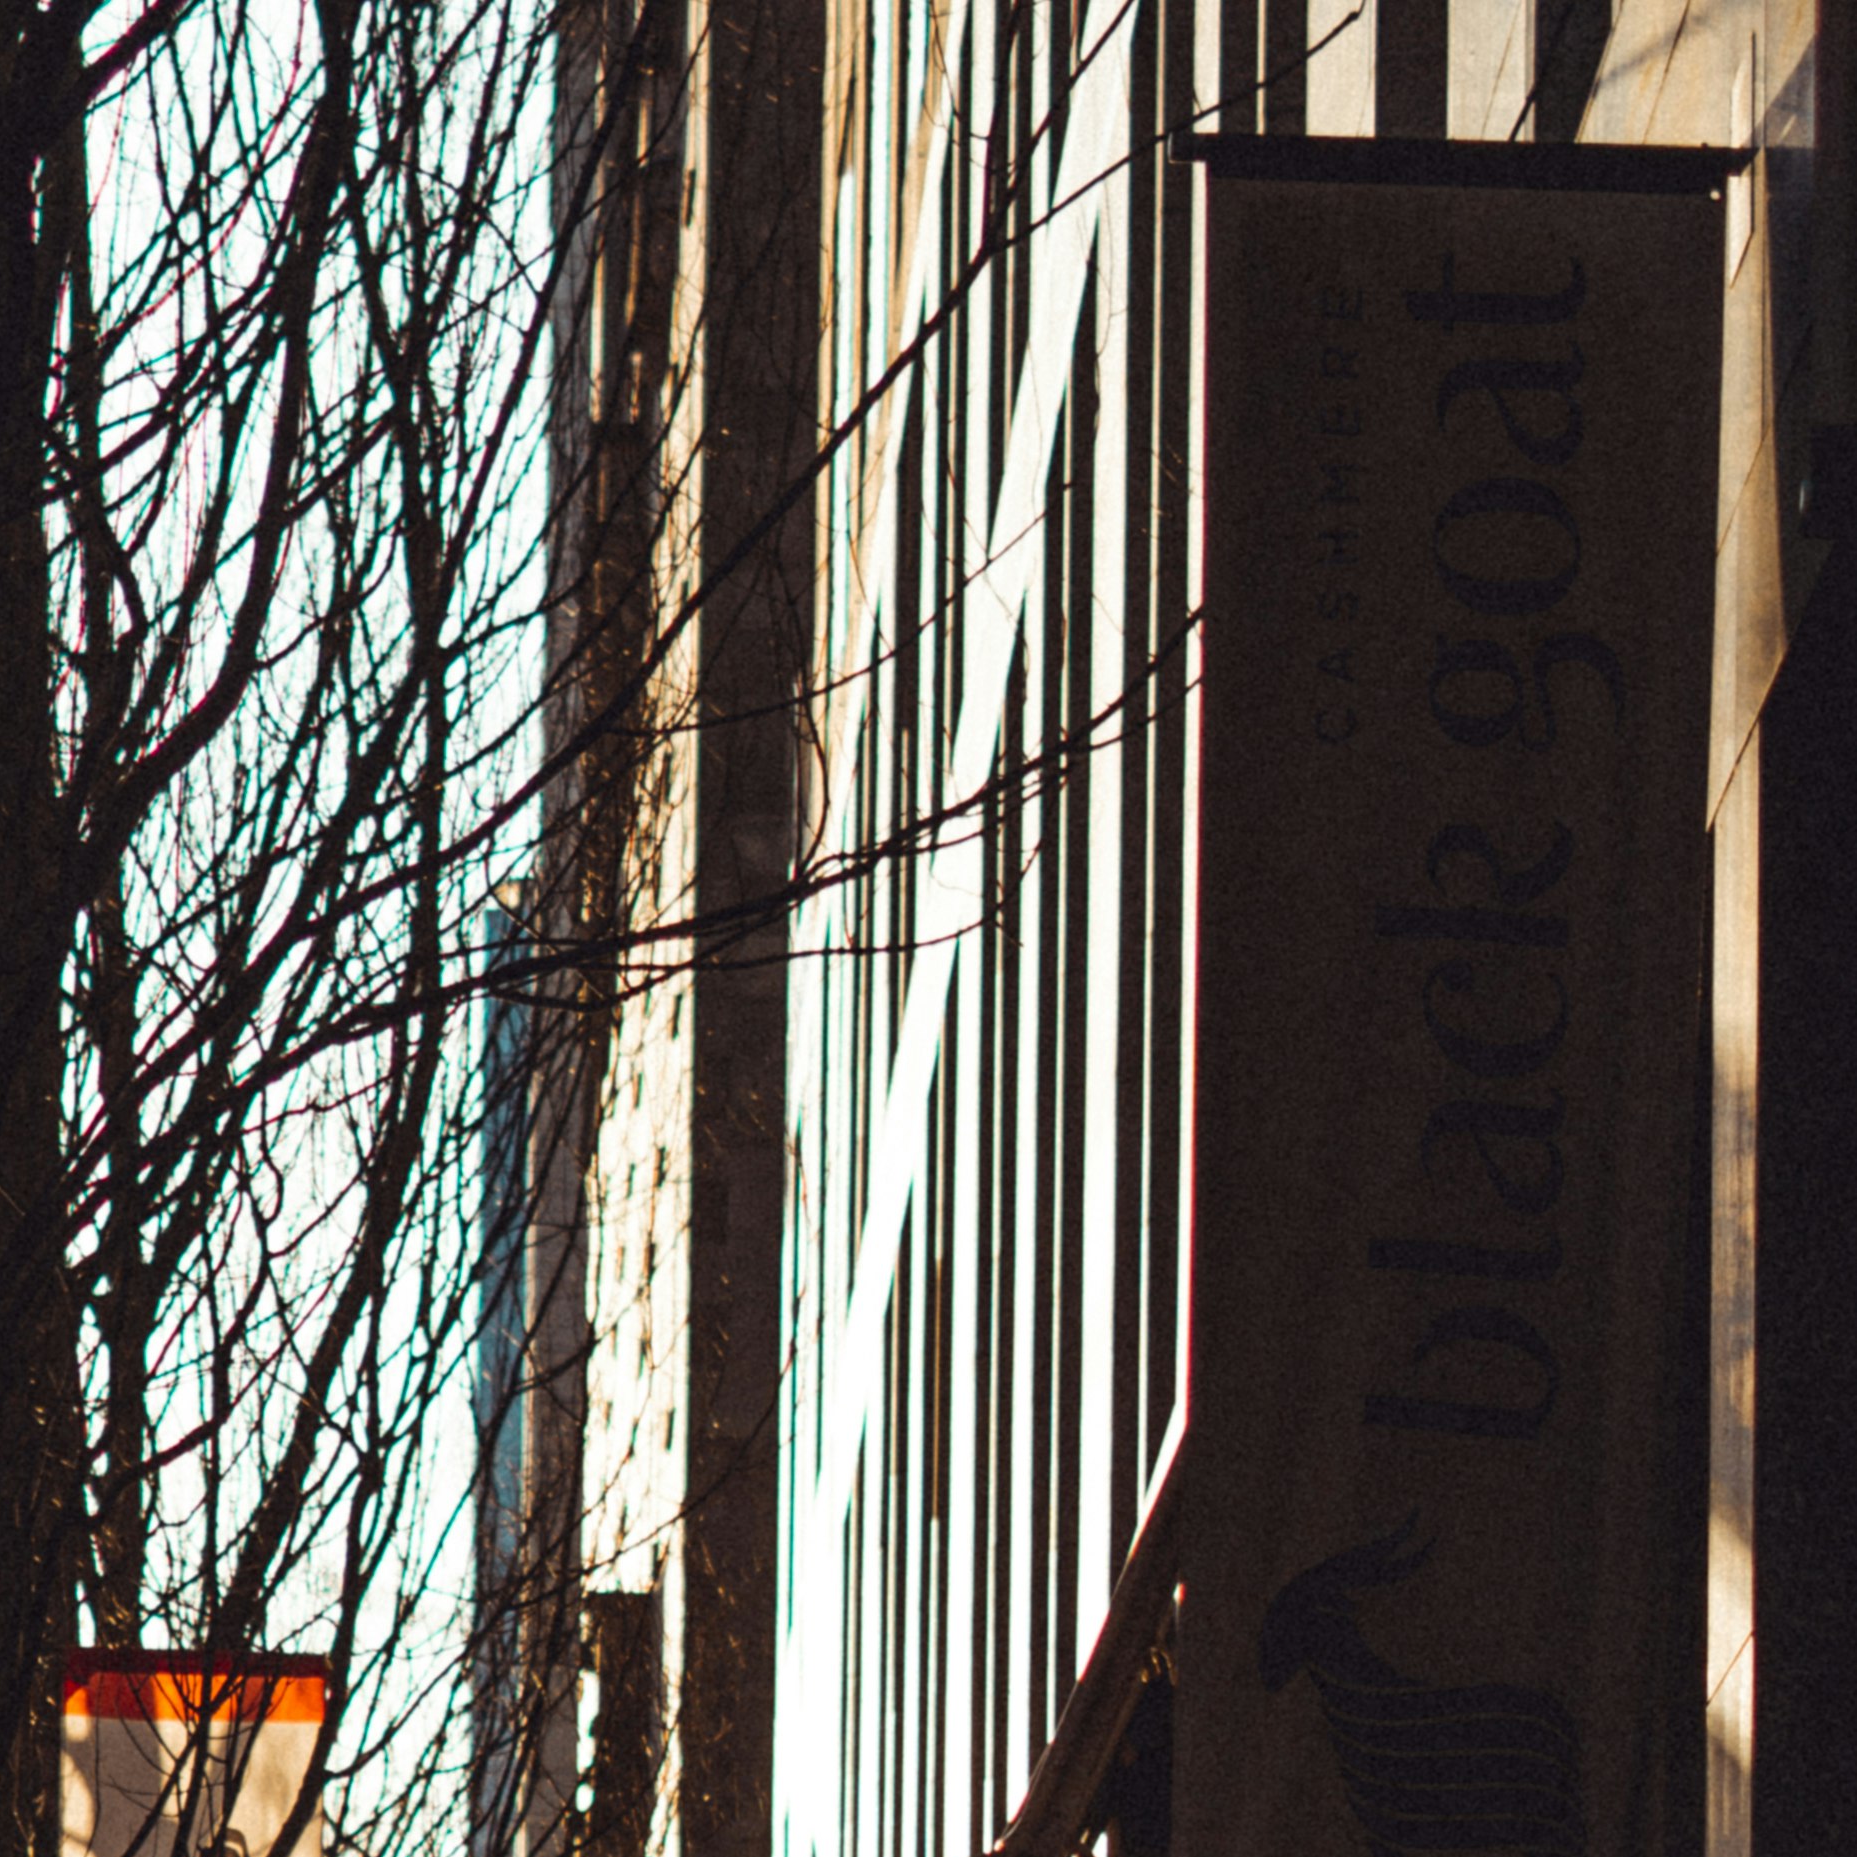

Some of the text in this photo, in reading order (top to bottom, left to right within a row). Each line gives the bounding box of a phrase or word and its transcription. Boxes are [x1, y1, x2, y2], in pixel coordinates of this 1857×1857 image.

[1315, 284, 1367, 749] CASHMERE
[1364, 251, 1628, 1441] black goat
